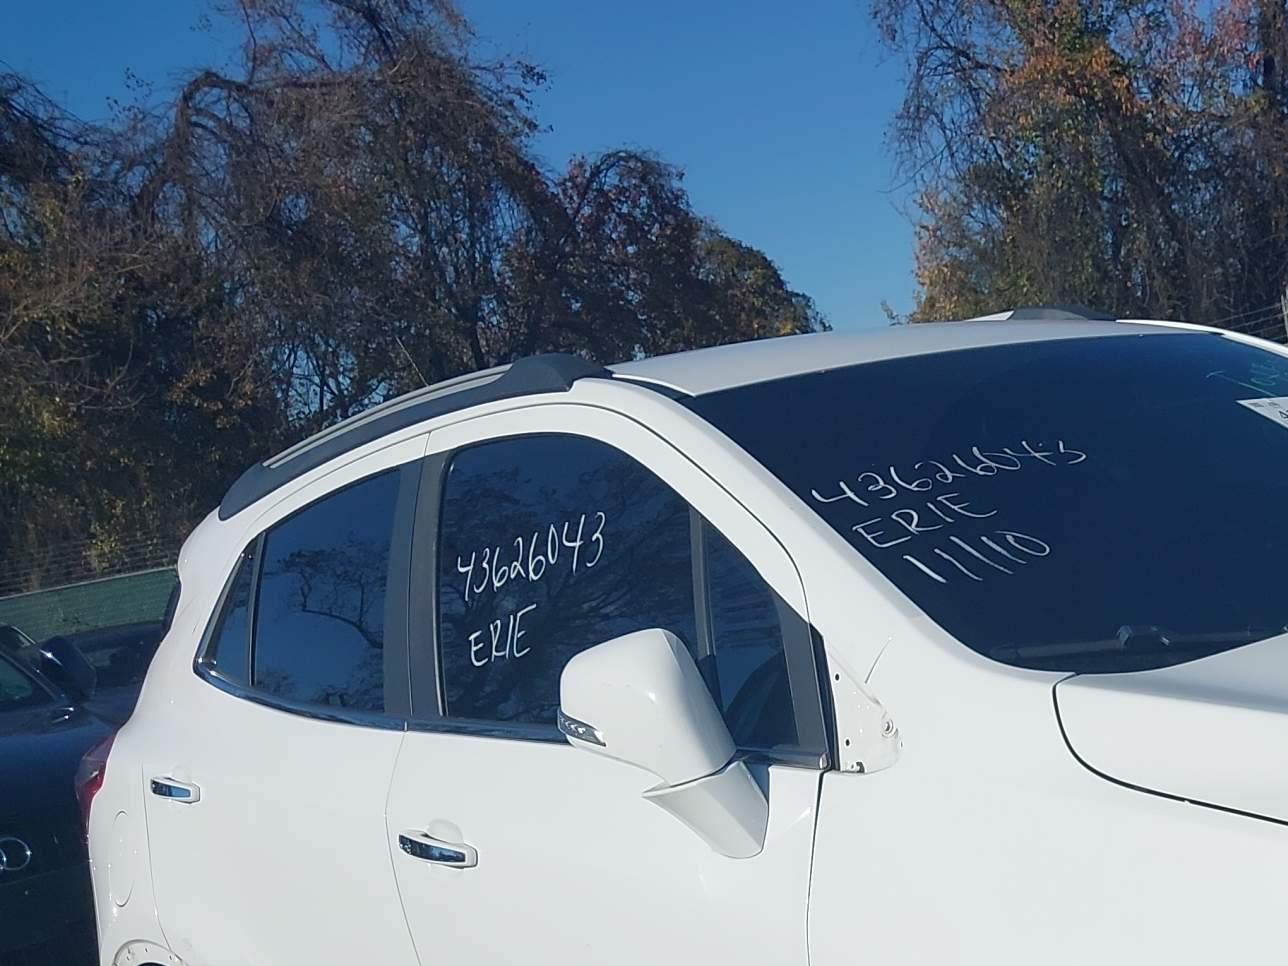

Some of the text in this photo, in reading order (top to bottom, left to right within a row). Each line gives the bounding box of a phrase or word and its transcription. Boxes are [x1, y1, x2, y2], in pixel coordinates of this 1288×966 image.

[852, 492, 998, 548] ERIE
[457, 511, 606, 602] 43626043
[469, 603, 537, 667] ERIE
